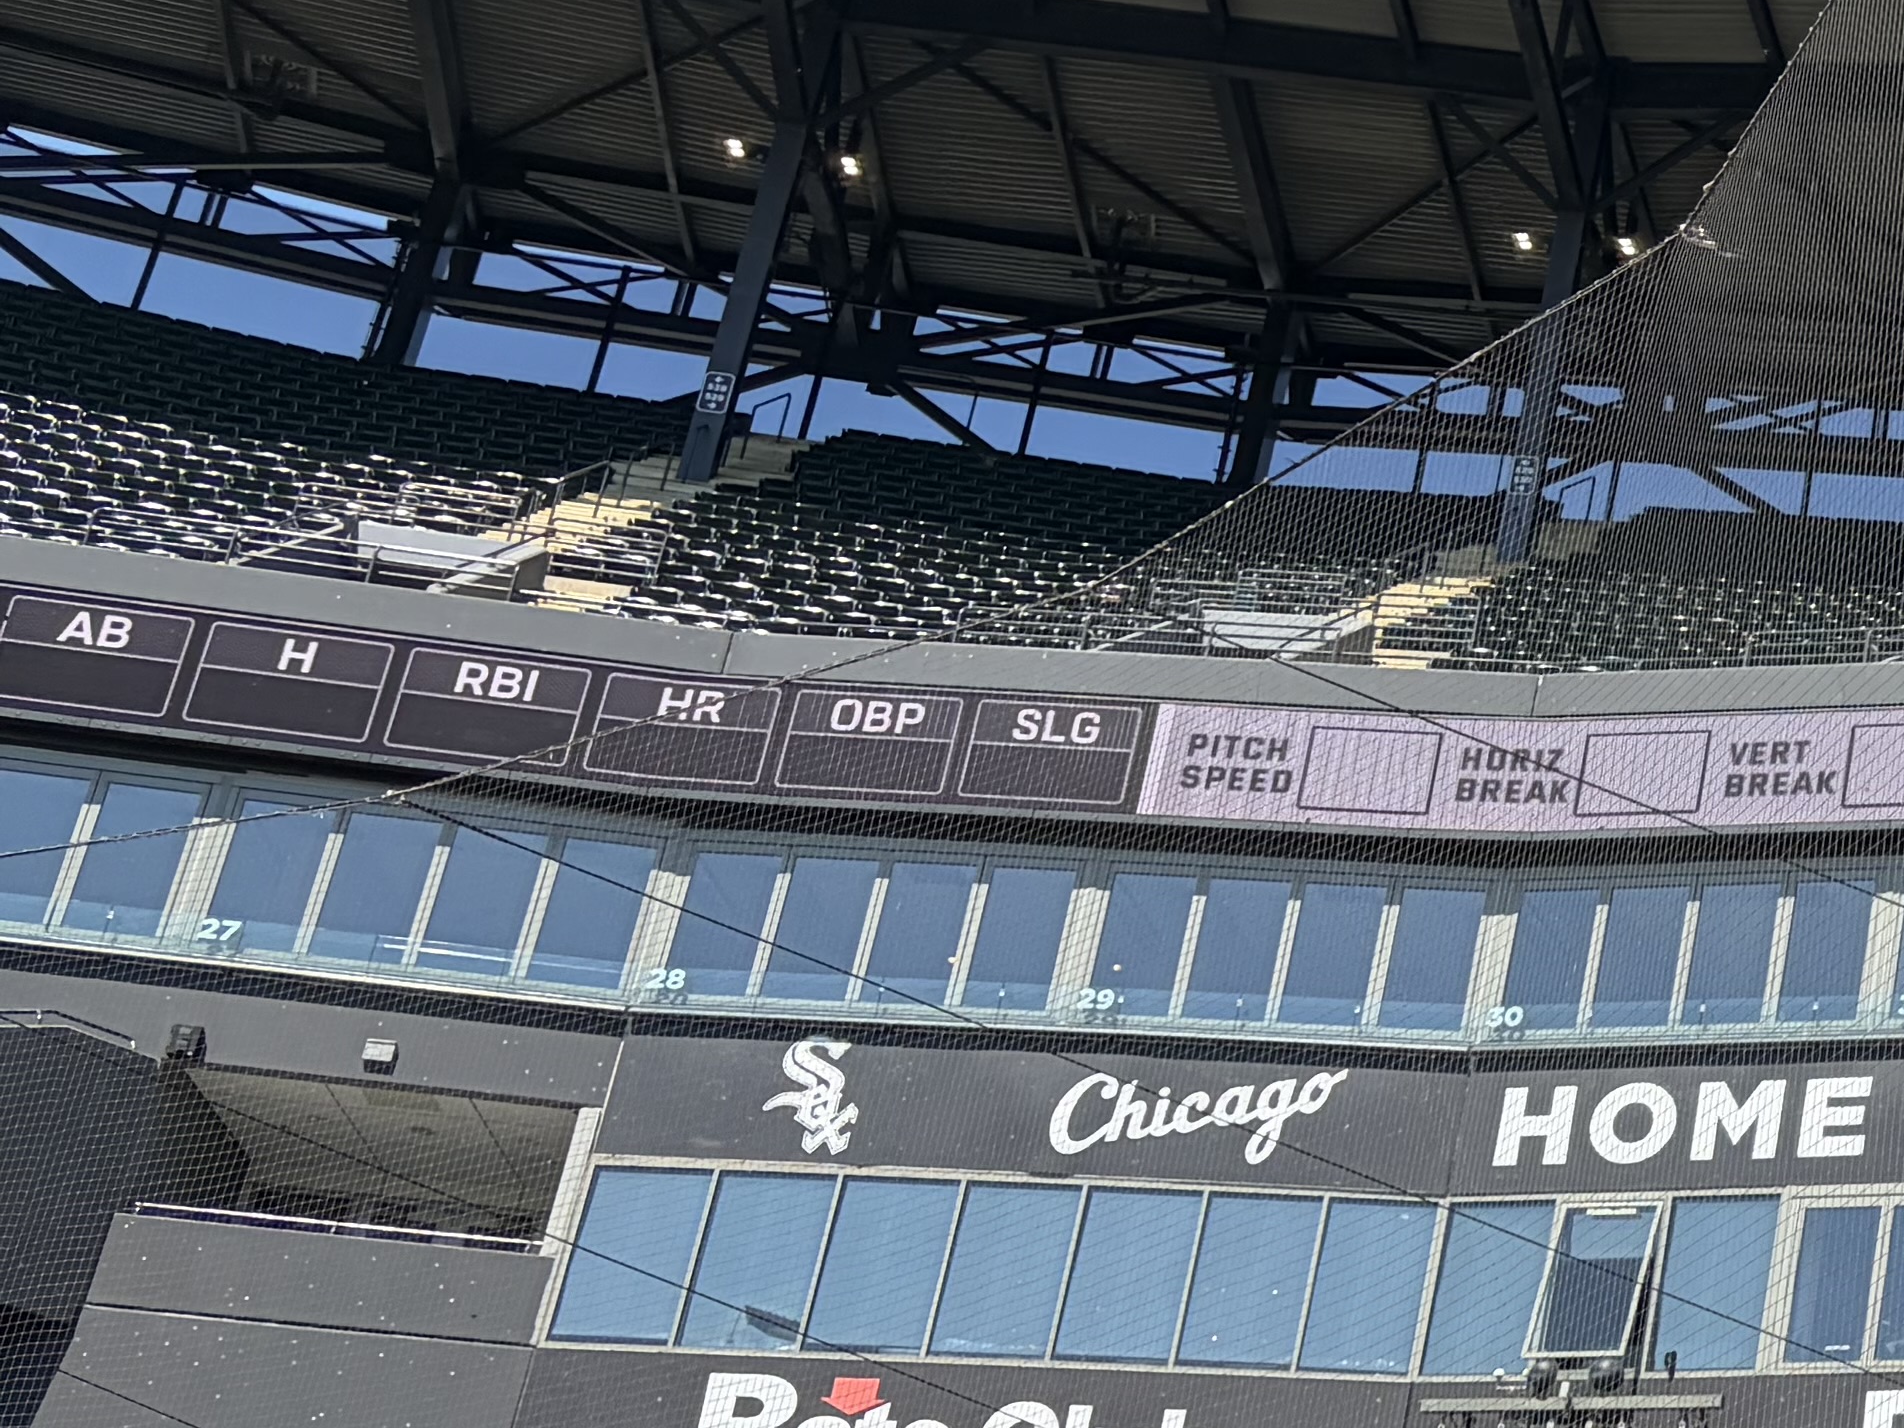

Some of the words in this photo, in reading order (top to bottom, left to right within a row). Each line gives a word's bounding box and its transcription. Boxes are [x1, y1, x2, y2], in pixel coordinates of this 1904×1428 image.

[58, 614, 133, 651] AB
[276, 640, 316, 675] H
[453, 662, 536, 703] RBI
[658, 687, 726, 725] HR
[830, 700, 925, 735] OBP
[1011, 708, 1100, 745] SLG
[1186, 732, 1289, 765] PITCH
[1460, 744, 1565, 772] HORIZ
[1728, 739, 1810, 767] VERT
[1180, 766, 1293, 795] SPEED
[1455, 775, 1569, 804] BREAK
[1724, 770, 1834, 799] BREAK
[198, 918, 243, 941] 27
[647, 969, 685, 991] 28
[1077, 990, 1115, 1011] 29
[1488, 1006, 1524, 1027] 30
[1050, 1069, 1349, 1165] Chicago
[1491, 1075, 1874, 1167] HOME
